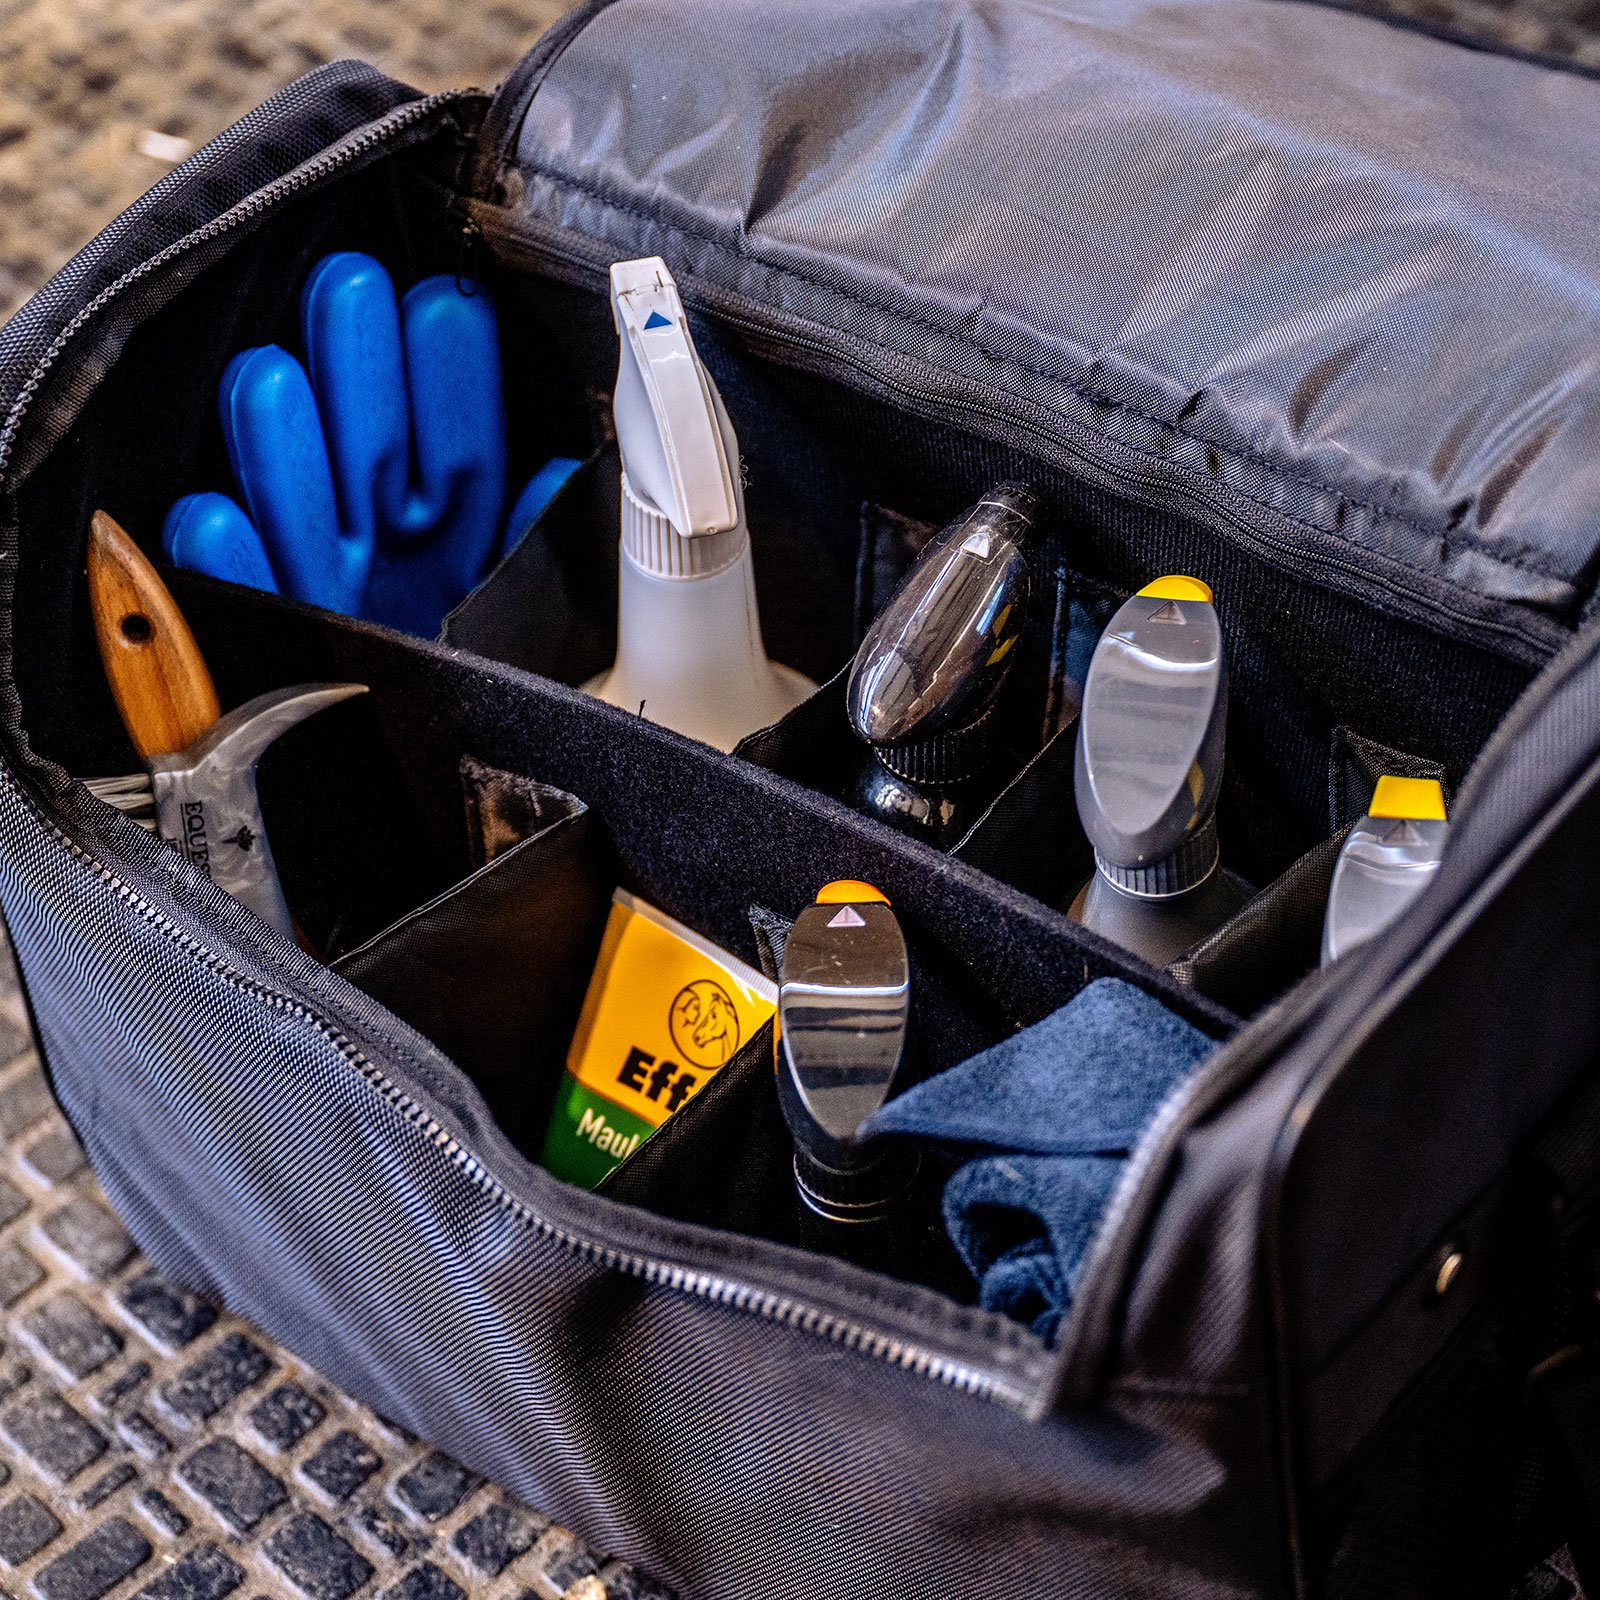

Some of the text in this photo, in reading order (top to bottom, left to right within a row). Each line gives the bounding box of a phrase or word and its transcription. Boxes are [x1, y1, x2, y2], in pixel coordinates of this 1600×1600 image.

[184, 800, 212, 878] EQUES
[616, 1045, 697, 1112] Eff
[576, 1107, 641, 1160] Maul
